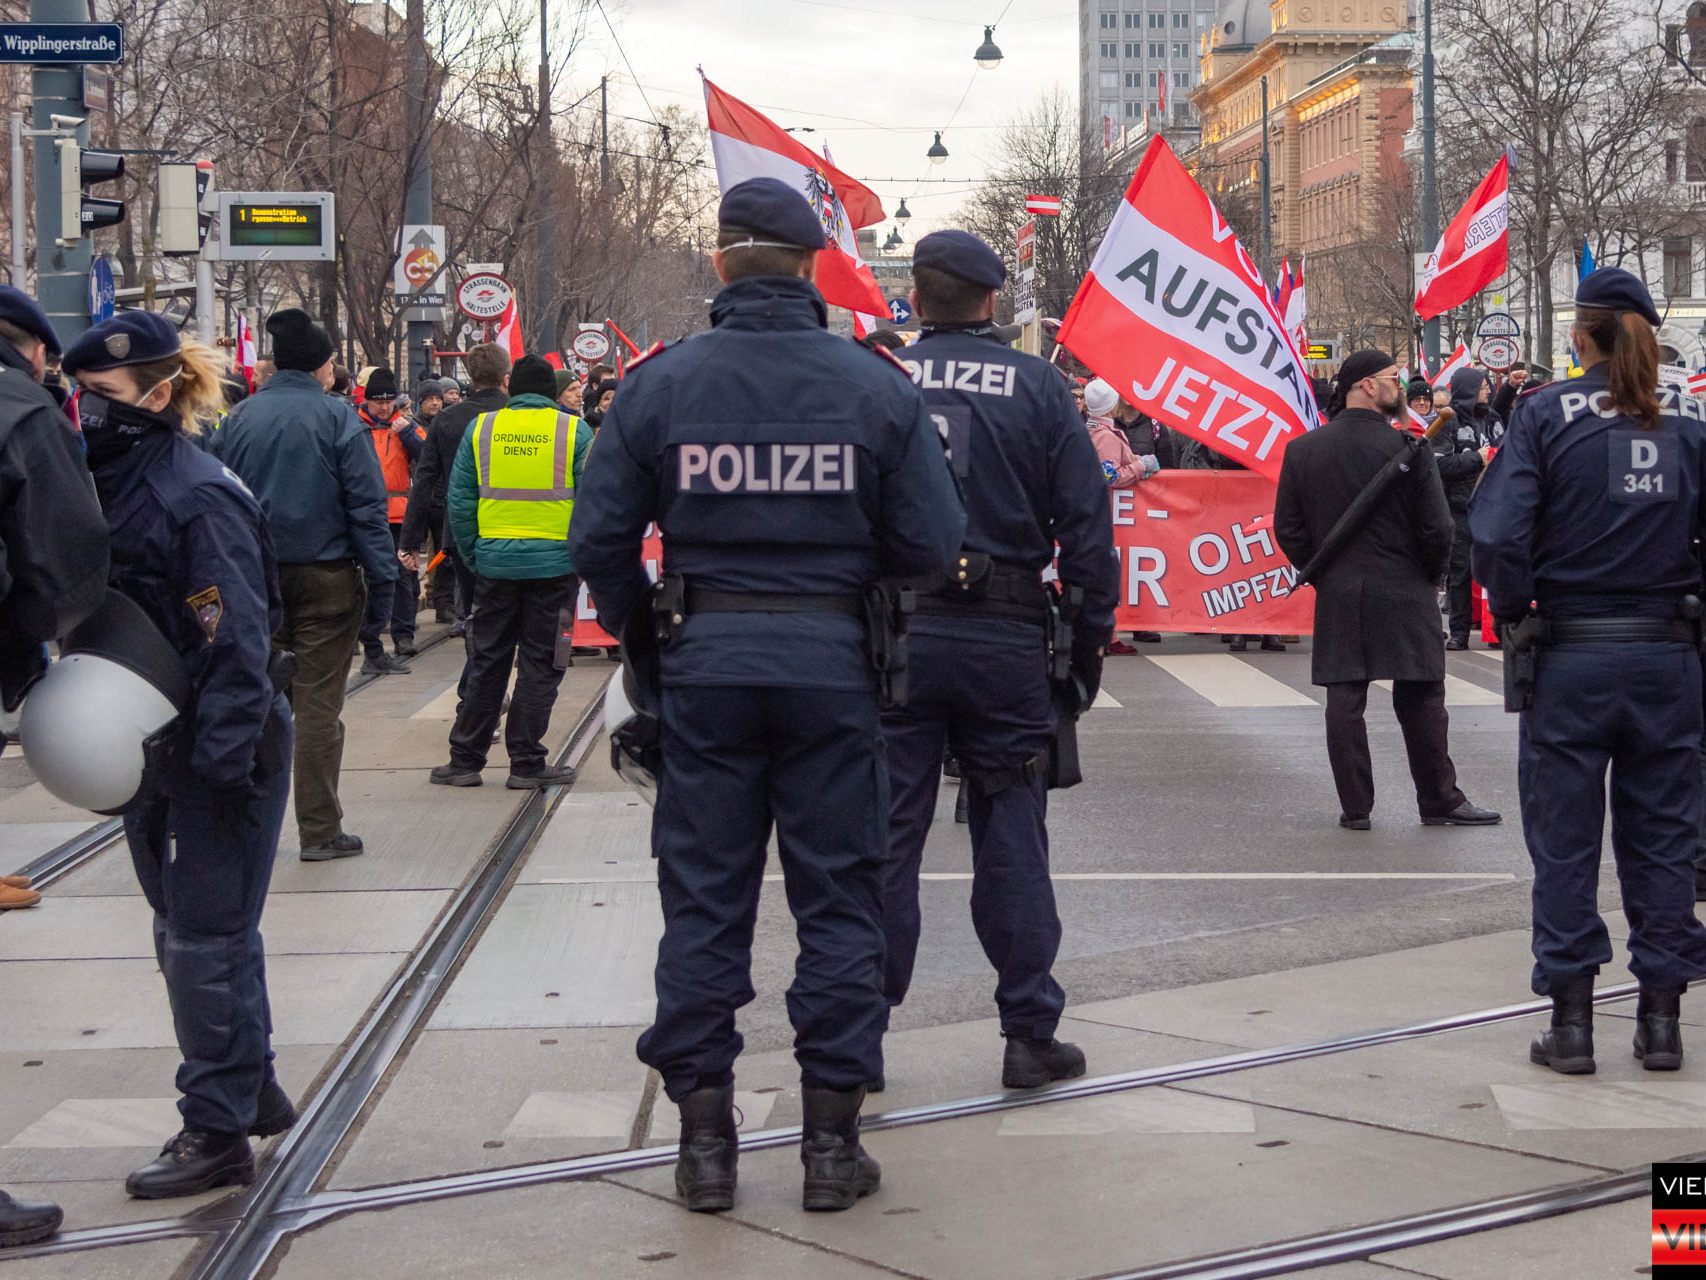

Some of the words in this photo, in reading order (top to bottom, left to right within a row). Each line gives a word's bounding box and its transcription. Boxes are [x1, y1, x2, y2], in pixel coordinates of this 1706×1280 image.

[3, 34, 117, 55] Wipplingerstraße
[240, 208, 246, 222] 1
[463, 279, 508, 294] STRASSENBAHN
[420, 296, 427, 304] in
[428, 296, 444, 304] Wien
[465, 301, 506, 314] HALTESTELLE
[903, 359, 1016, 397] OLIZEI
[1132, 356, 1292, 462] JETZT
[1560, 386, 1706, 422] POZEI
[493, 433, 552, 444] ORDNUNGS-
[503, 446, 539, 456] DIENST
[1631, 439, 1659, 469] D
[680, 444, 854, 492] POLIZEI
[1623, 474, 1664, 493] 341
[1189, 516, 1275, 576] OH
